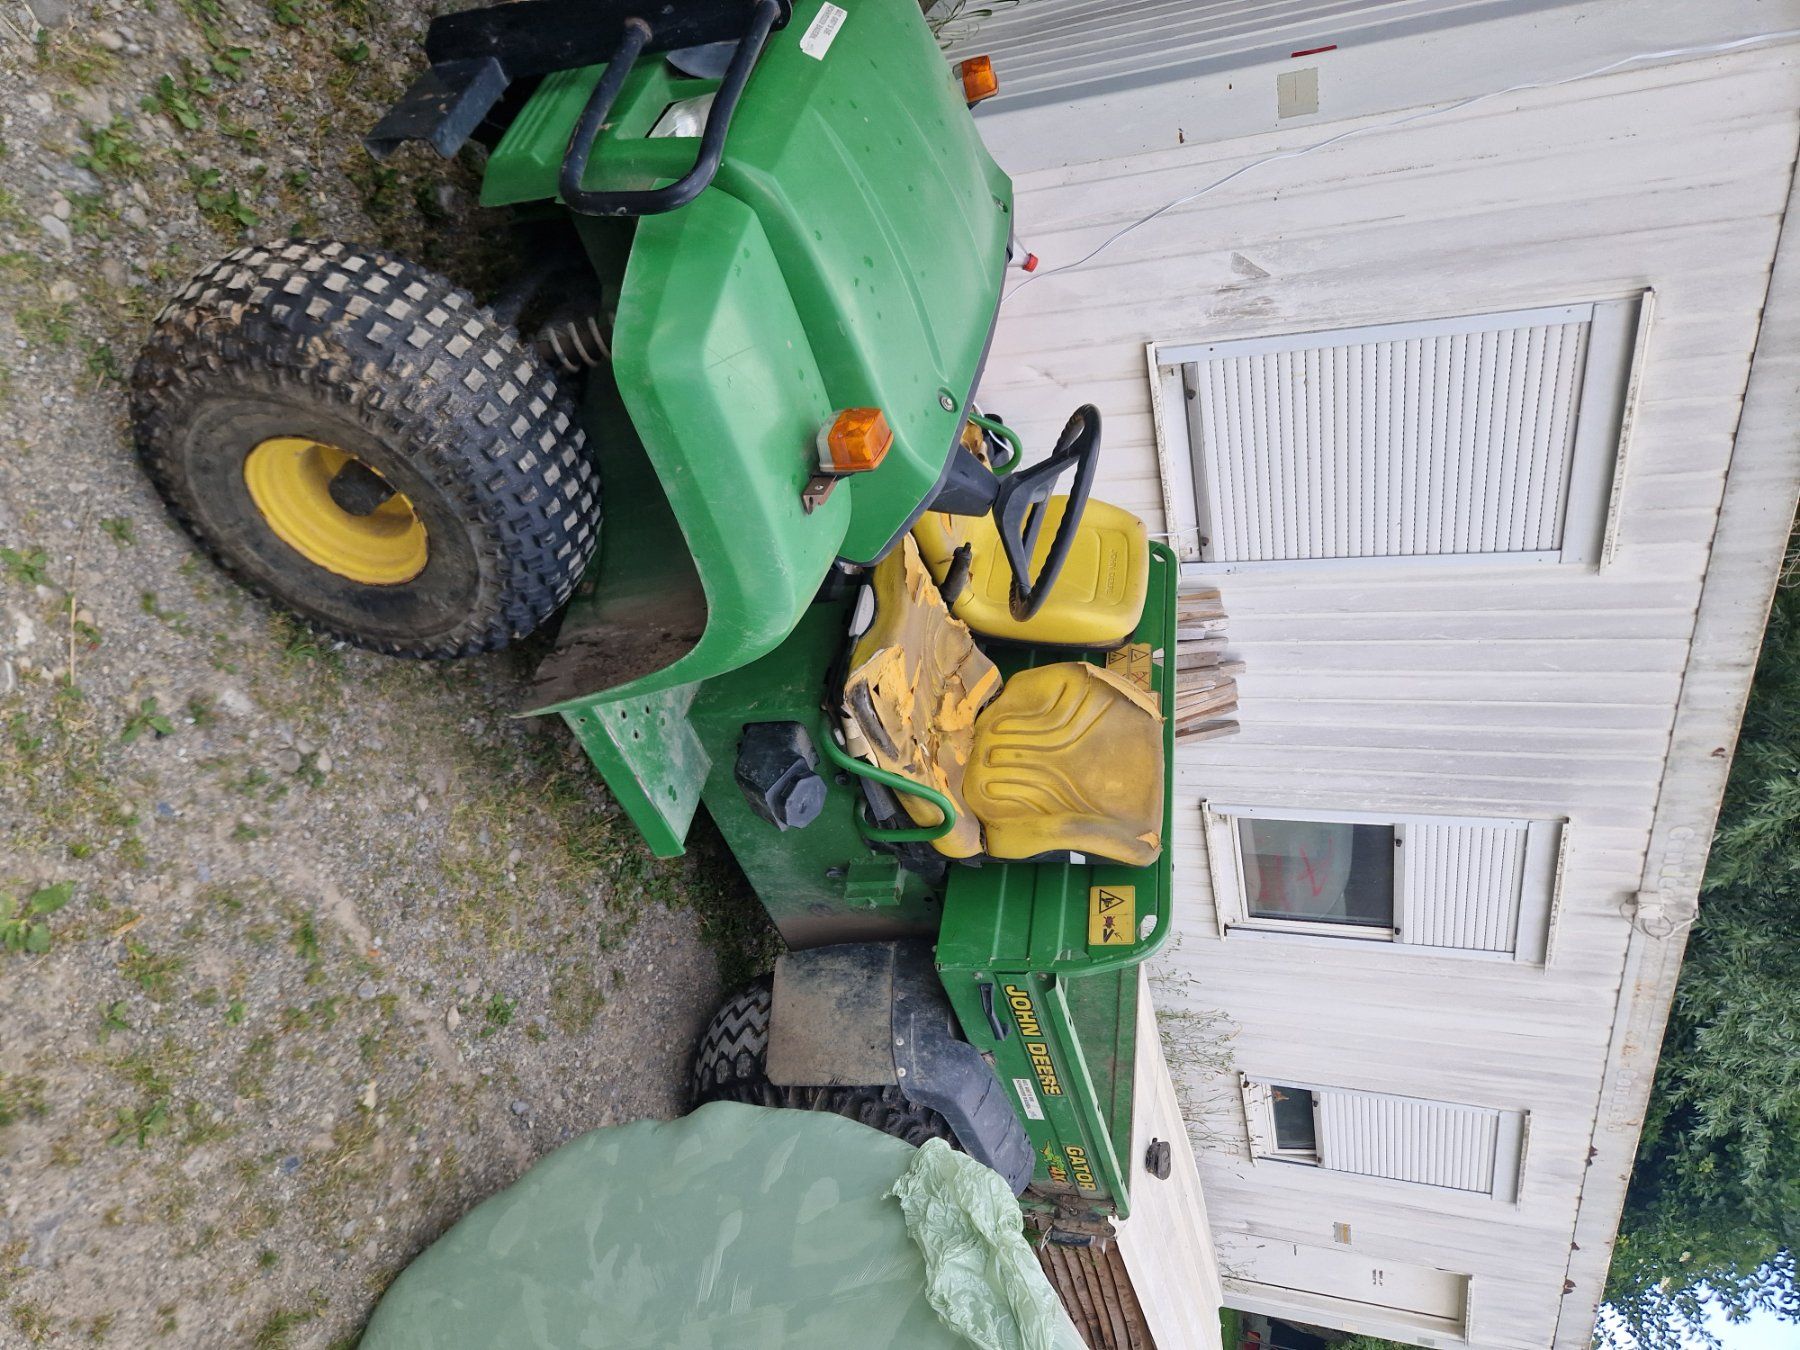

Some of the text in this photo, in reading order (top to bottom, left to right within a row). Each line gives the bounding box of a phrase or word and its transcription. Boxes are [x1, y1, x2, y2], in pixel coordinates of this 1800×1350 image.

[1004, 985, 1042, 1037] JOHN
[1025, 1042, 1064, 1096] DEERE
[1064, 1145, 1097, 1191] GATOR
